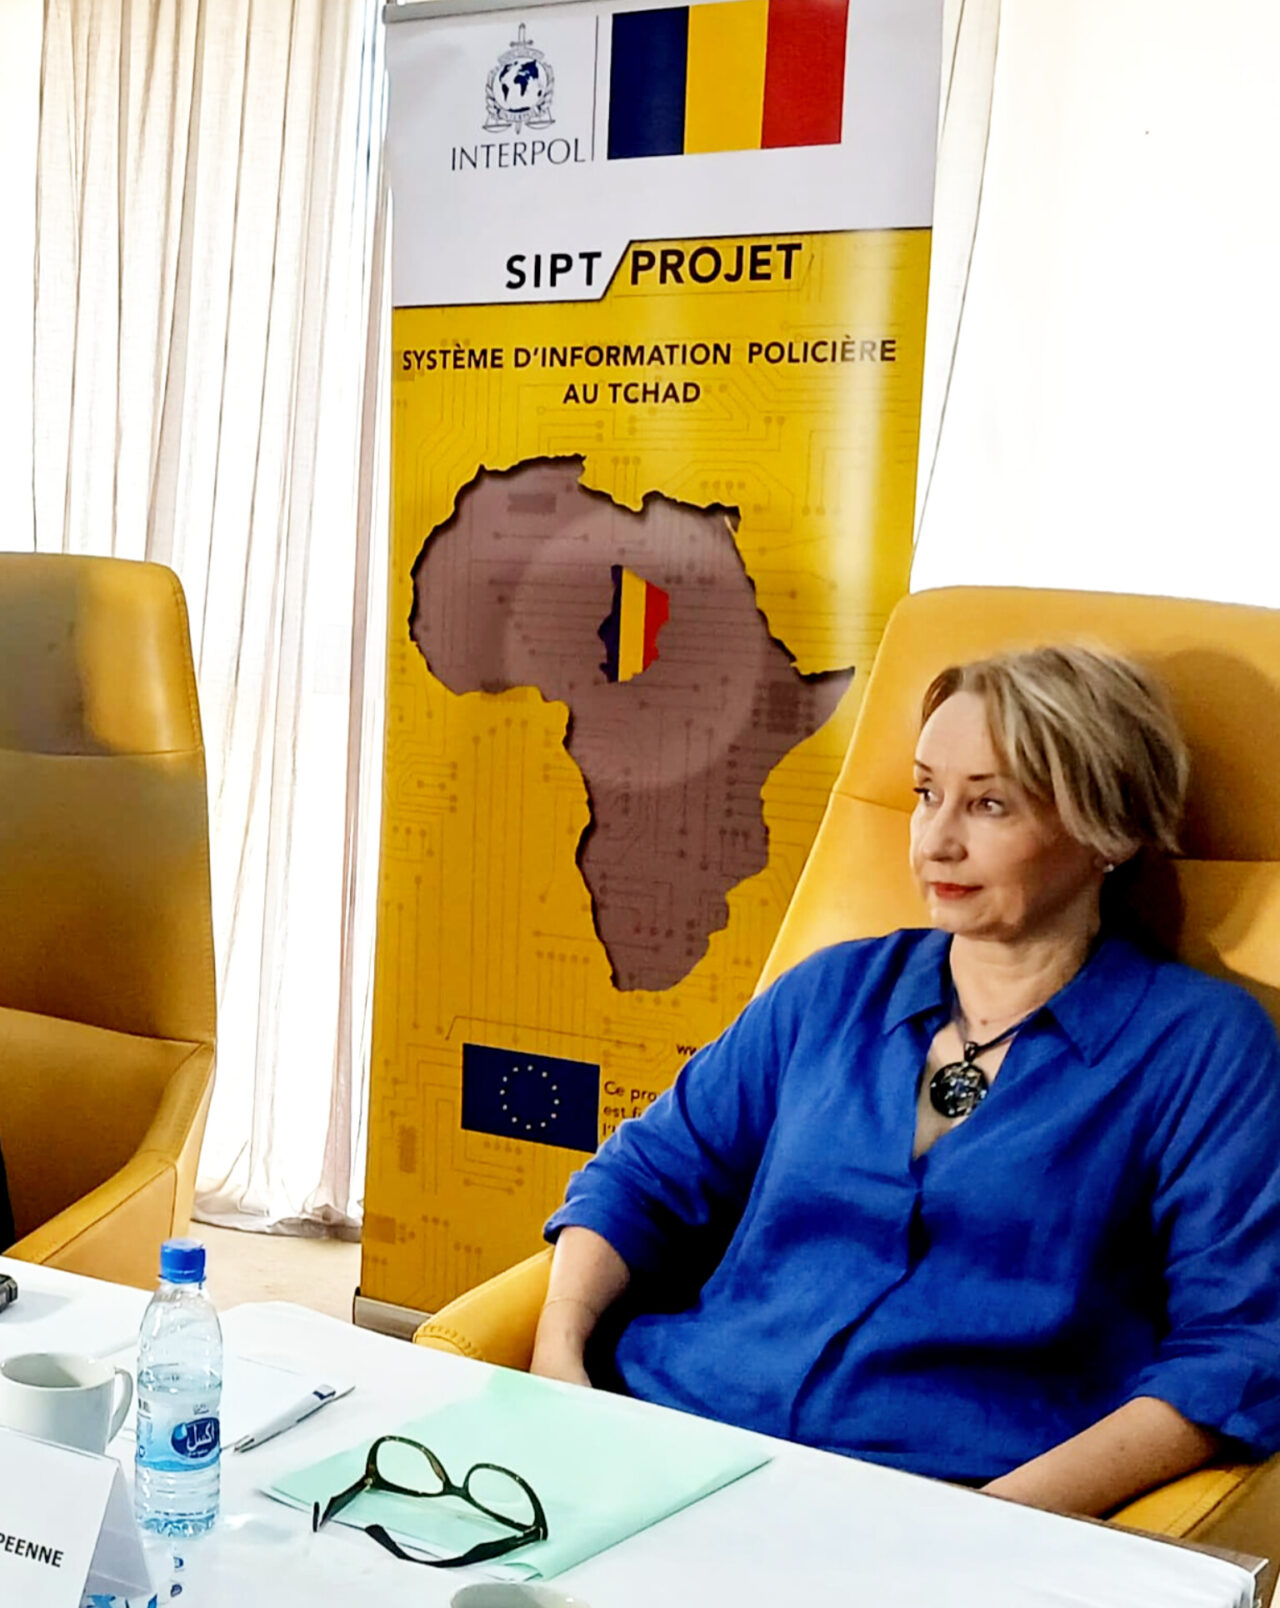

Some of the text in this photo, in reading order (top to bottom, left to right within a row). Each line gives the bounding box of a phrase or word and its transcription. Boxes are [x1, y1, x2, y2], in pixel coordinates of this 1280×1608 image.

[451, 137, 586, 171] INTERPOL
[506, 242, 803, 290] SIPT PROJET
[402, 333, 897, 371] SYSTÈME D'INFORMATION POLICIÈRE
[562, 381, 702, 406] AU TCHAD
[604, 1080, 625, 1097] Ce
[603, 1105, 625, 1119] est
